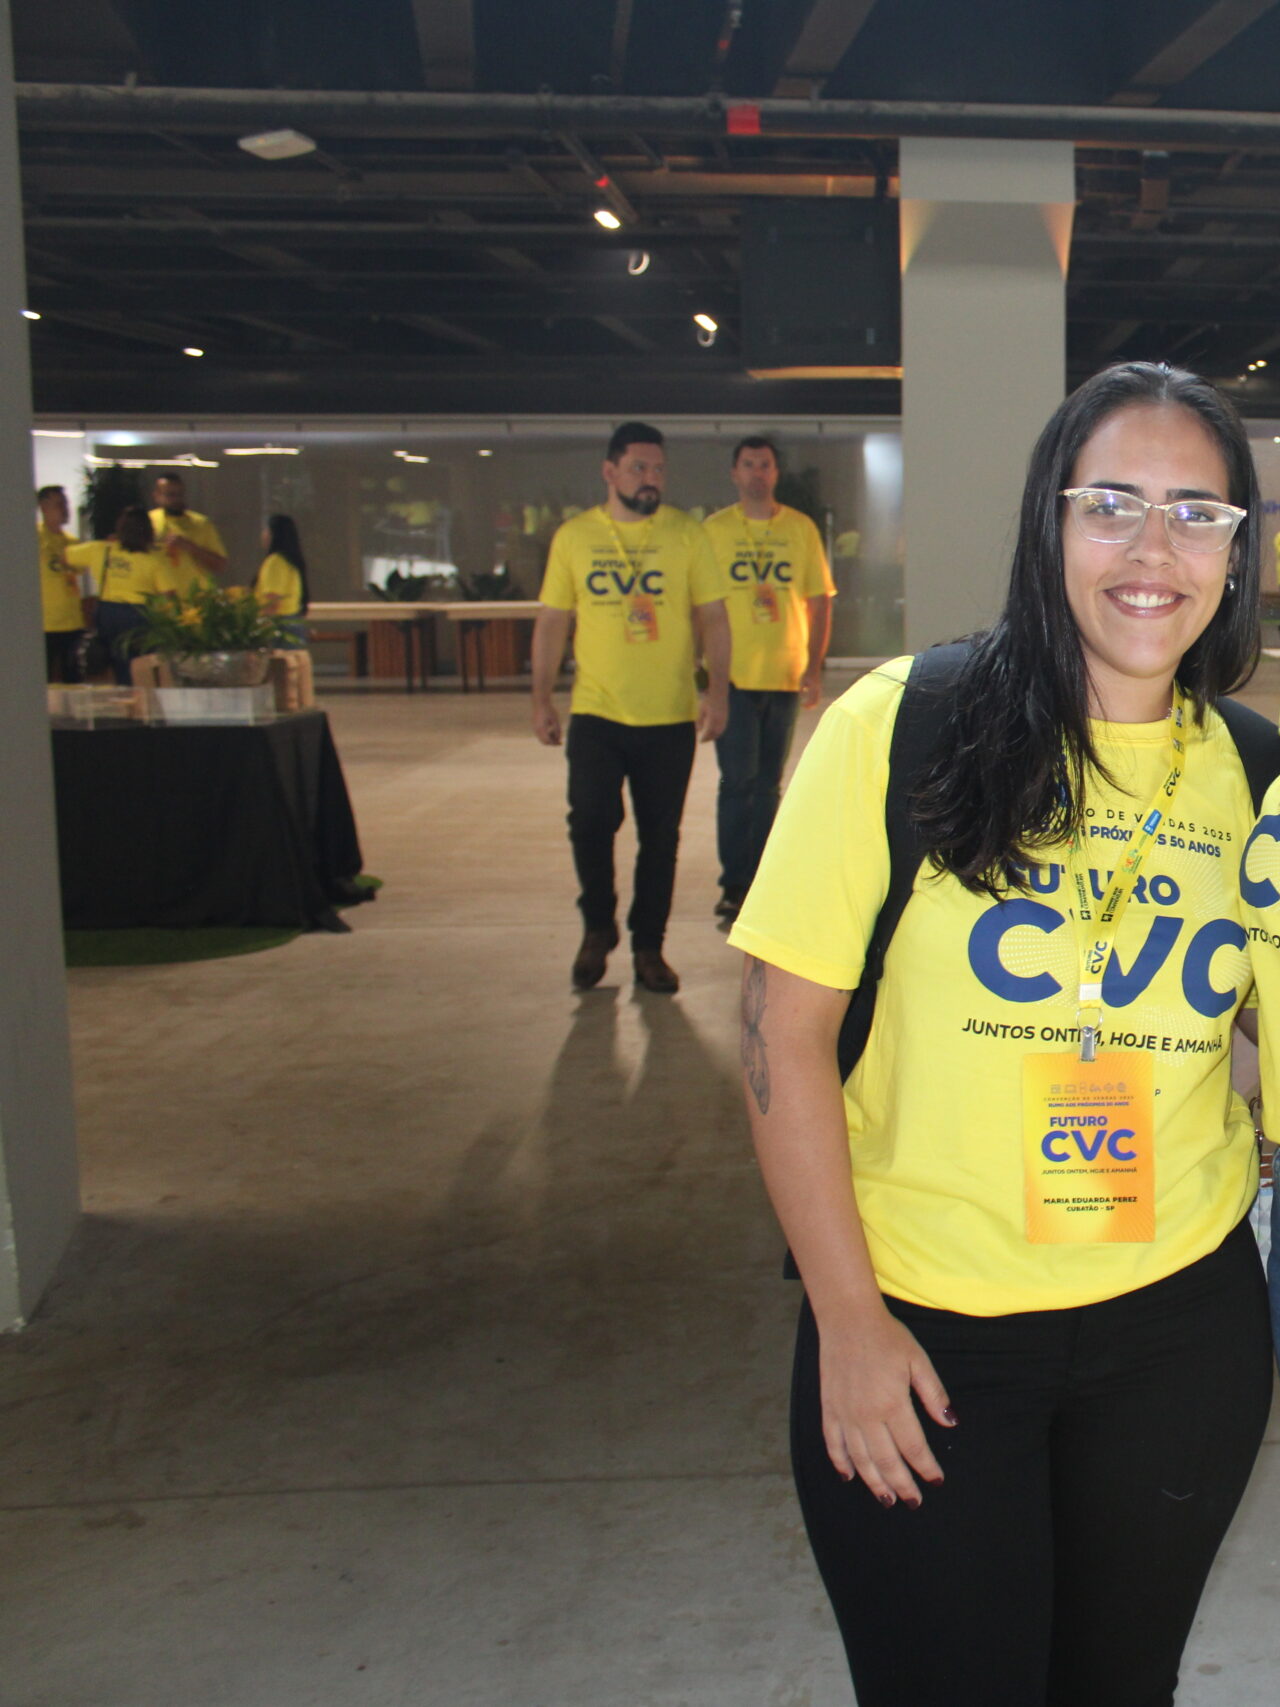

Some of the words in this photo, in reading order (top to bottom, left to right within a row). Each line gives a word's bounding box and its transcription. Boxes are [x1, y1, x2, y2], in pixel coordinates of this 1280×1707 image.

[586, 570, 664, 595] CVC
[729, 561, 792, 584] CVC
[1166, 768, 1181, 797] CVC
[1106, 809, 1125, 821] DE
[1134, 813, 1195, 833] VDAS
[1202, 826, 1232, 842] 2025
[1170, 836, 1185, 848] 50
[1188, 840, 1221, 857] ANOS
[968, 898, 1247, 1018] CVC
[1091, 941, 1107, 974] CVC
[962, 1018, 1035, 1040] JUNTOS
[1110, 1032, 1157, 1050] HOJE
[1162, 1037, 1172, 1051] E
[1050, 1115, 1108, 1127] FUTURO
[1041, 1129, 1137, 1162] CVC
[1066, 1204, 1098, 1212] CUBATÃO
